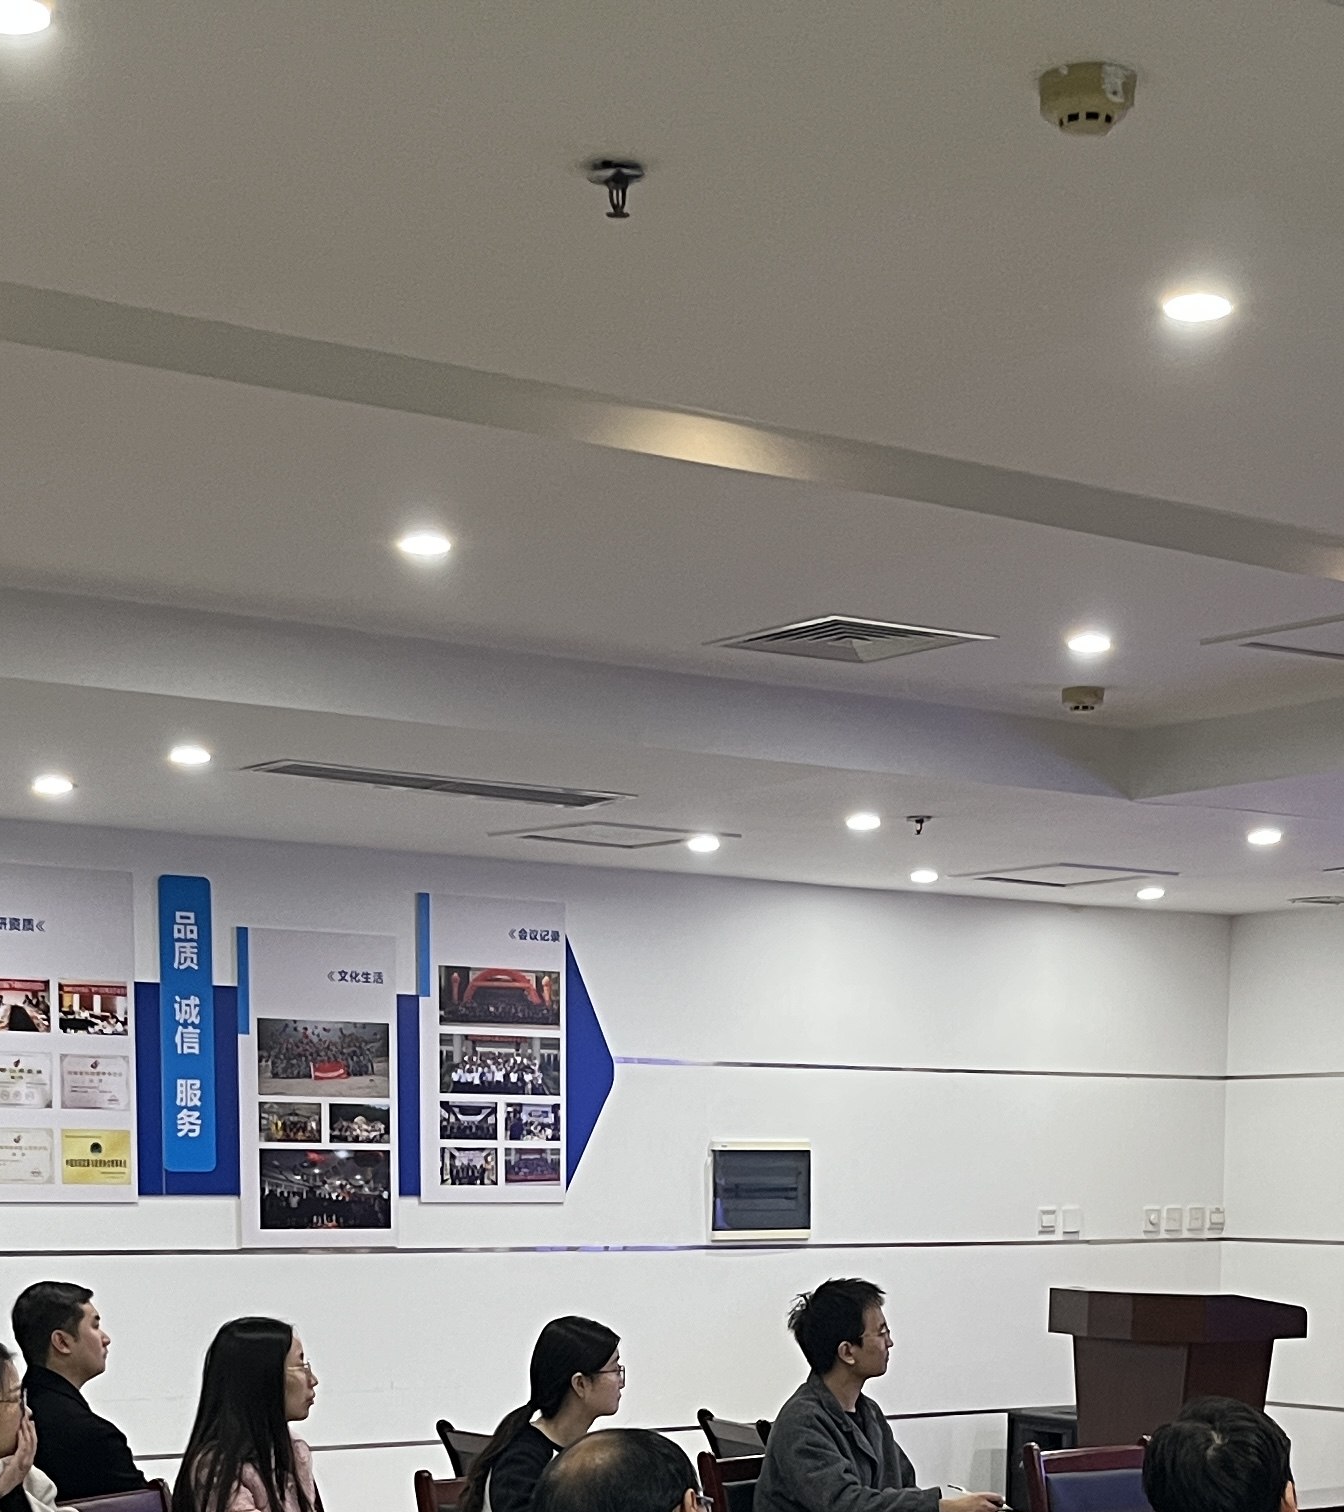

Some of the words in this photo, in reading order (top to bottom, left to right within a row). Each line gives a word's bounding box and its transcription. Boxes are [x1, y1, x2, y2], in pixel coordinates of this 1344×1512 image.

[172, 911, 199, 970] 品质
[518, 927, 560, 942] 会议记录
[337, 969, 384, 984] 文化生活
[173, 994, 200, 1055] 诚信
[175, 1079, 202, 1138] 服务
